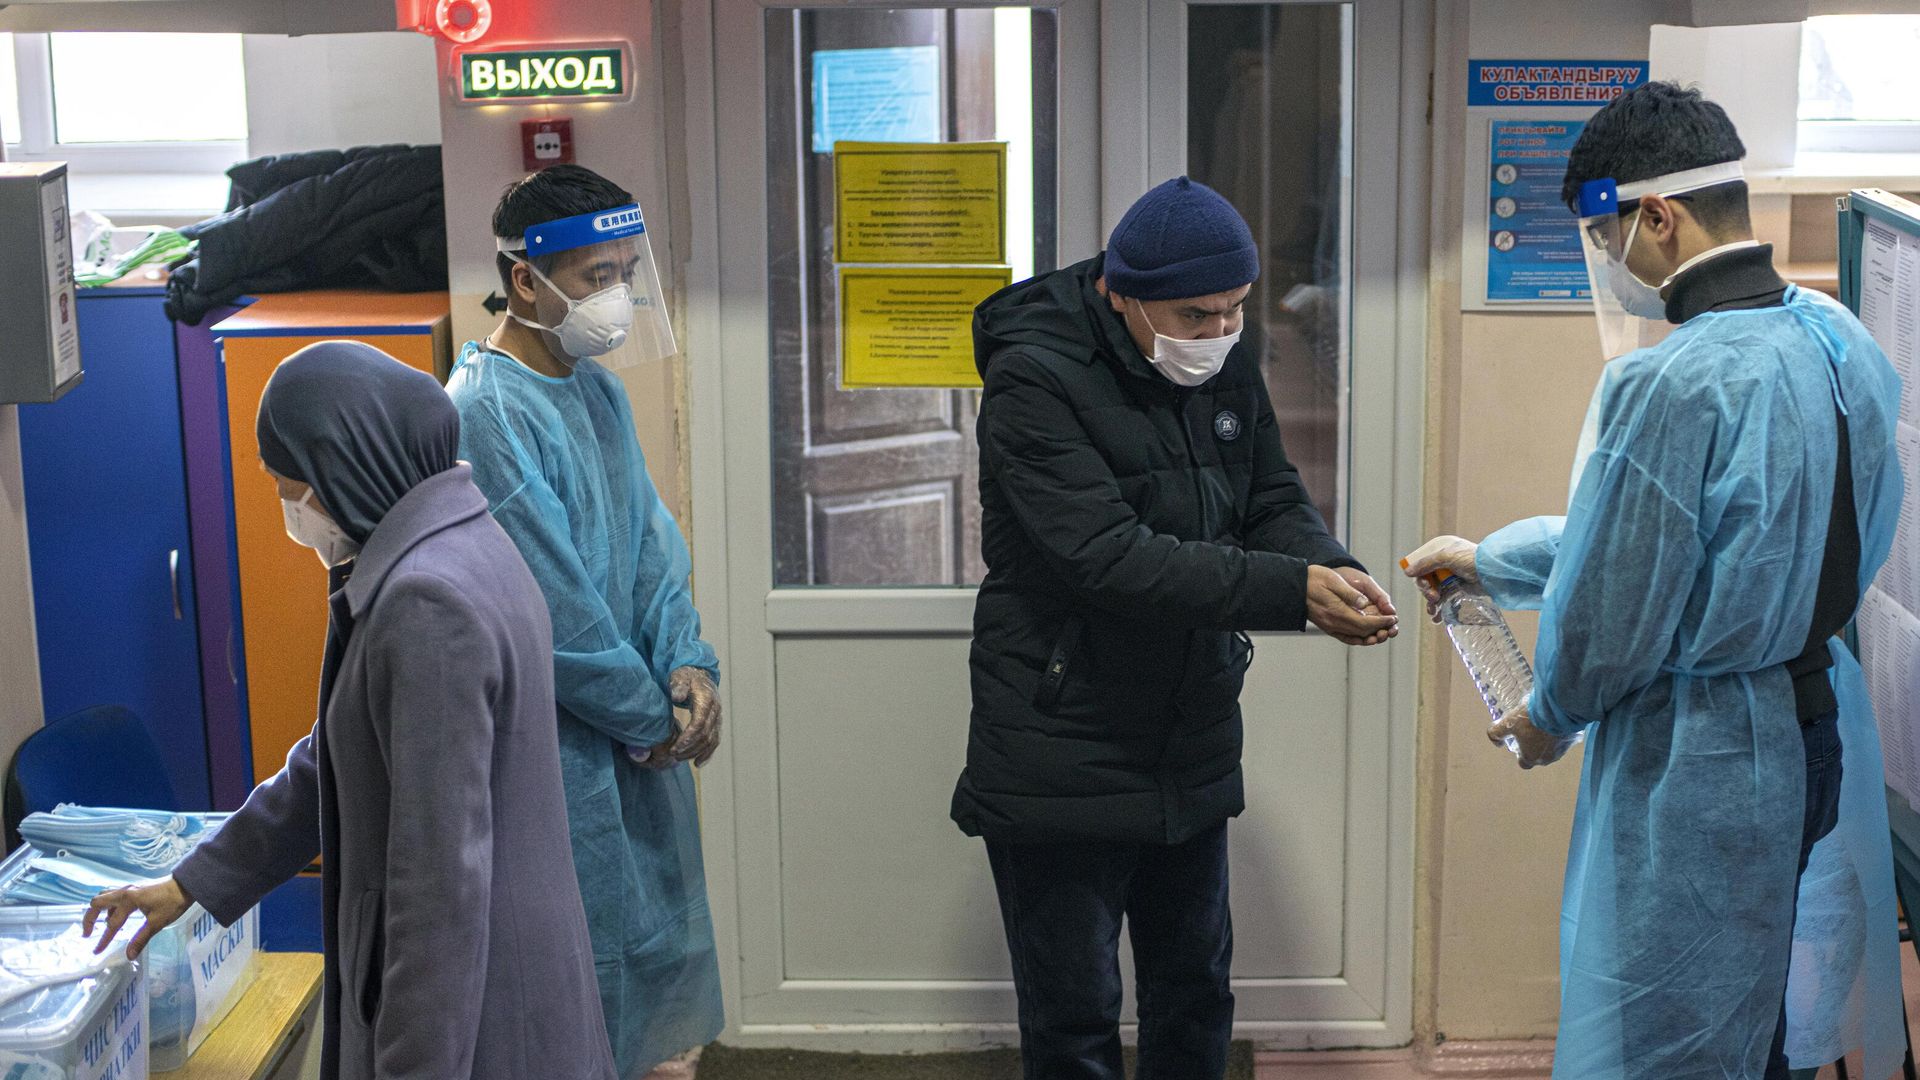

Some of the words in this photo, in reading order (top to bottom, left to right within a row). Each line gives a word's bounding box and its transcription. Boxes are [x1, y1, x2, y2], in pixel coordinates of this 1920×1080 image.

[470, 56, 615, 91] ВЫХОД
[1480, 66, 1641, 84] КУЛАКТАНДЫРУУ
[1495, 86, 1623, 101] ОБЪЯВЛЕНИЯ
[201, 915, 244, 988] МАСКИ
[84, 976, 138, 1067] ЧИСТЫЕ
[100, 1021, 140, 1080] ЧАТКИ
